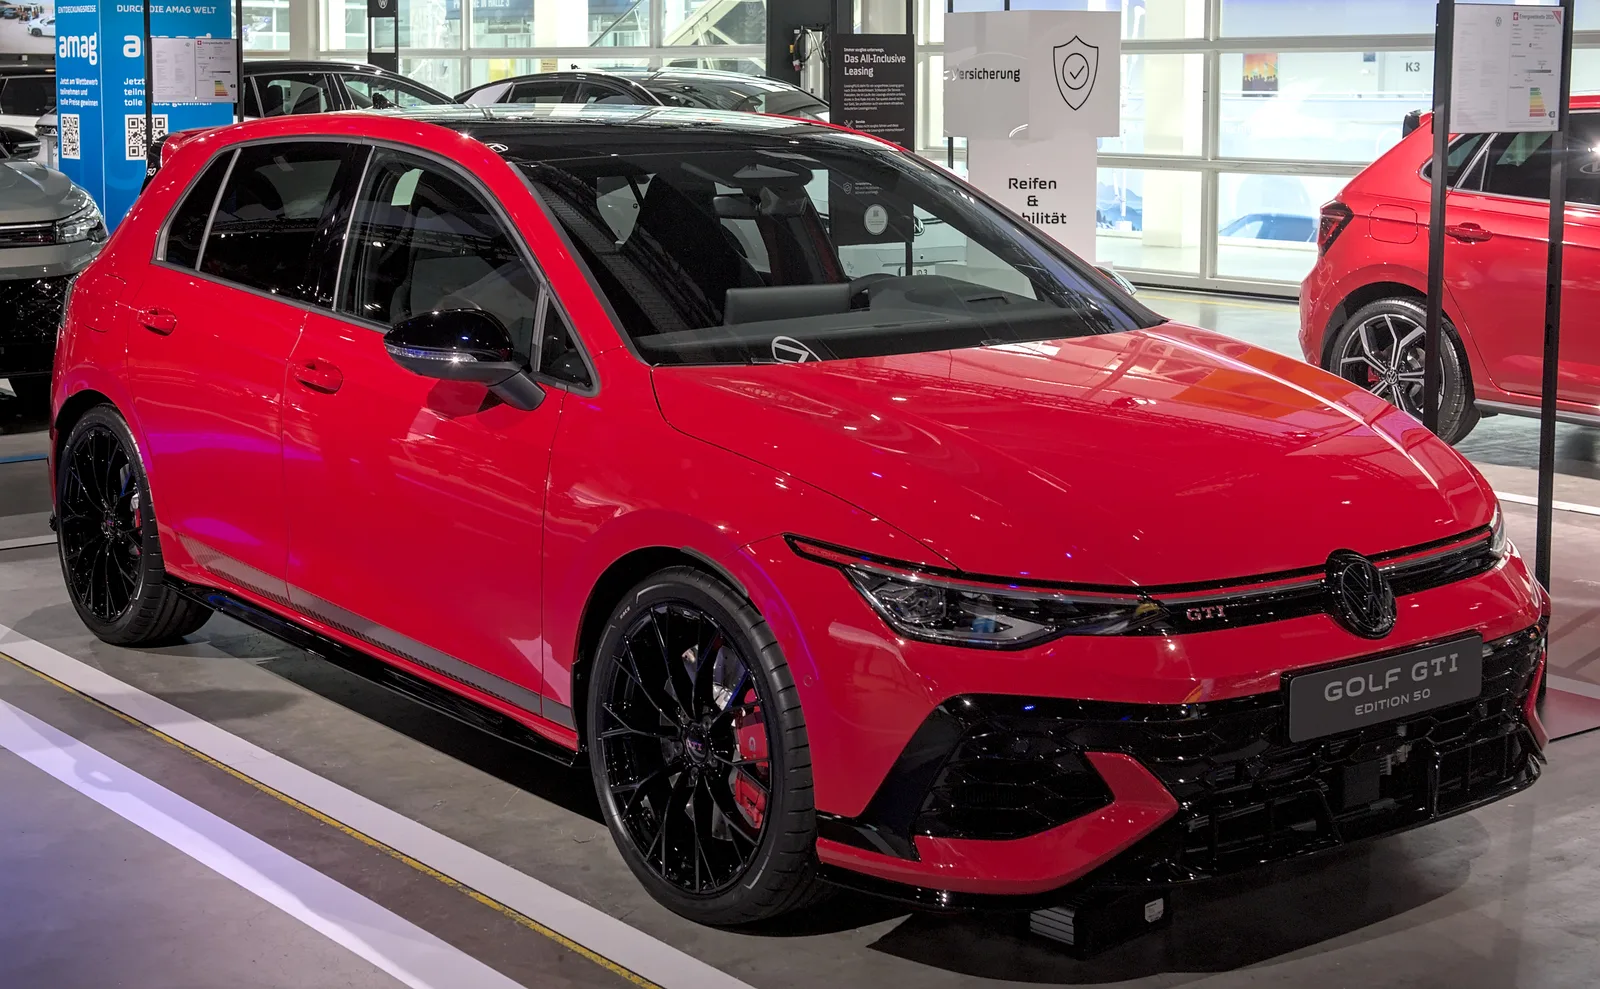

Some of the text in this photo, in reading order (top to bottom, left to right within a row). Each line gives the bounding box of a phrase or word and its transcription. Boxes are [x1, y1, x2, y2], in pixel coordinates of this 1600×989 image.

[166, 6, 191, 14] AMAG
[59, 32, 97, 65] amag
[844, 54, 906, 63] Das All-Inclusive
[844, 66, 874, 78] Leasing
[1405, 62, 1421, 72] K3
[69, 98, 80, 106] Preise
[124, 98, 142, 106] tolle
[1008, 177, 1057, 190] Reifen
[1027, 195, 1039, 207] &
[1186, 605, 1226, 621] GTI
[1324, 653, 1459, 702] GOLF GTI
[1354, 688, 1431, 716] EDITION 50
